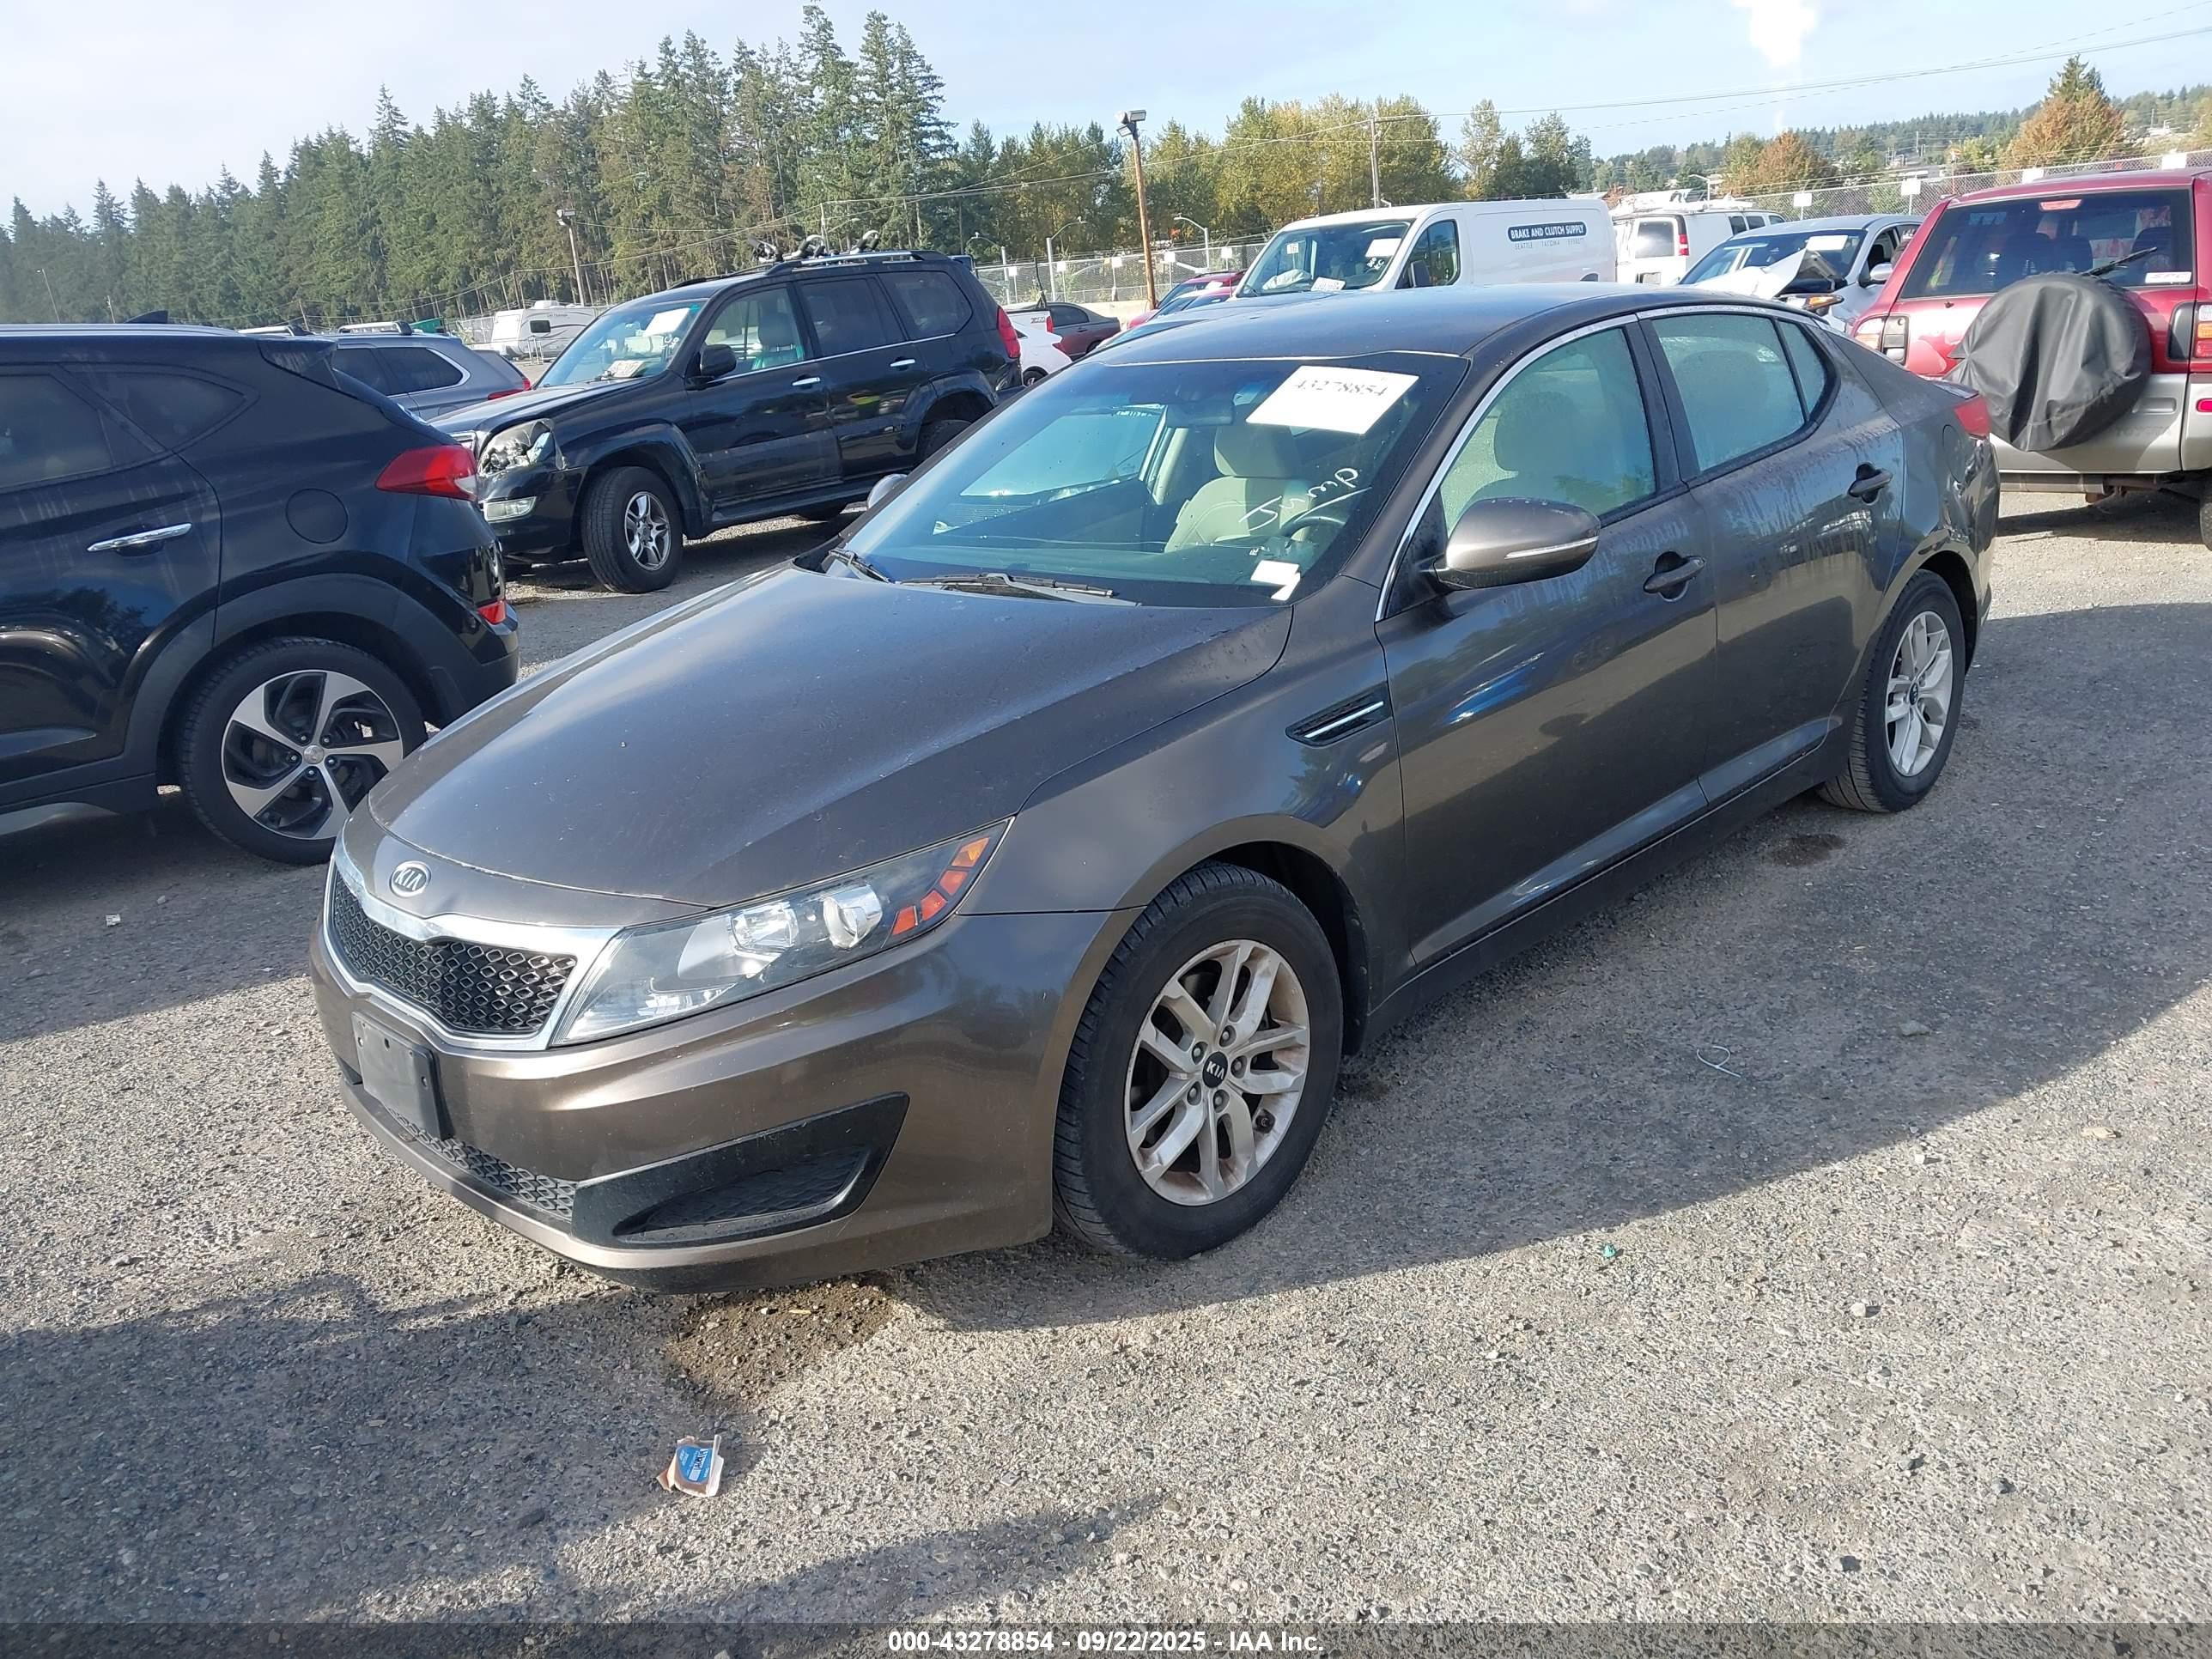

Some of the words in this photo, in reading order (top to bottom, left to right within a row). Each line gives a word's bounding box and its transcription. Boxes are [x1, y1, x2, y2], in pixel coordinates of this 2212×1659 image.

[1510, 228, 1530, 239] BRAKE
[1531, 228, 1544, 237] AND
[1545, 225, 1565, 236] CLUTCH
[1566, 224, 1583, 234] SUPPLY
[395, 868, 422, 891] KIA
[1206, 1060, 1224, 1080] KIA
